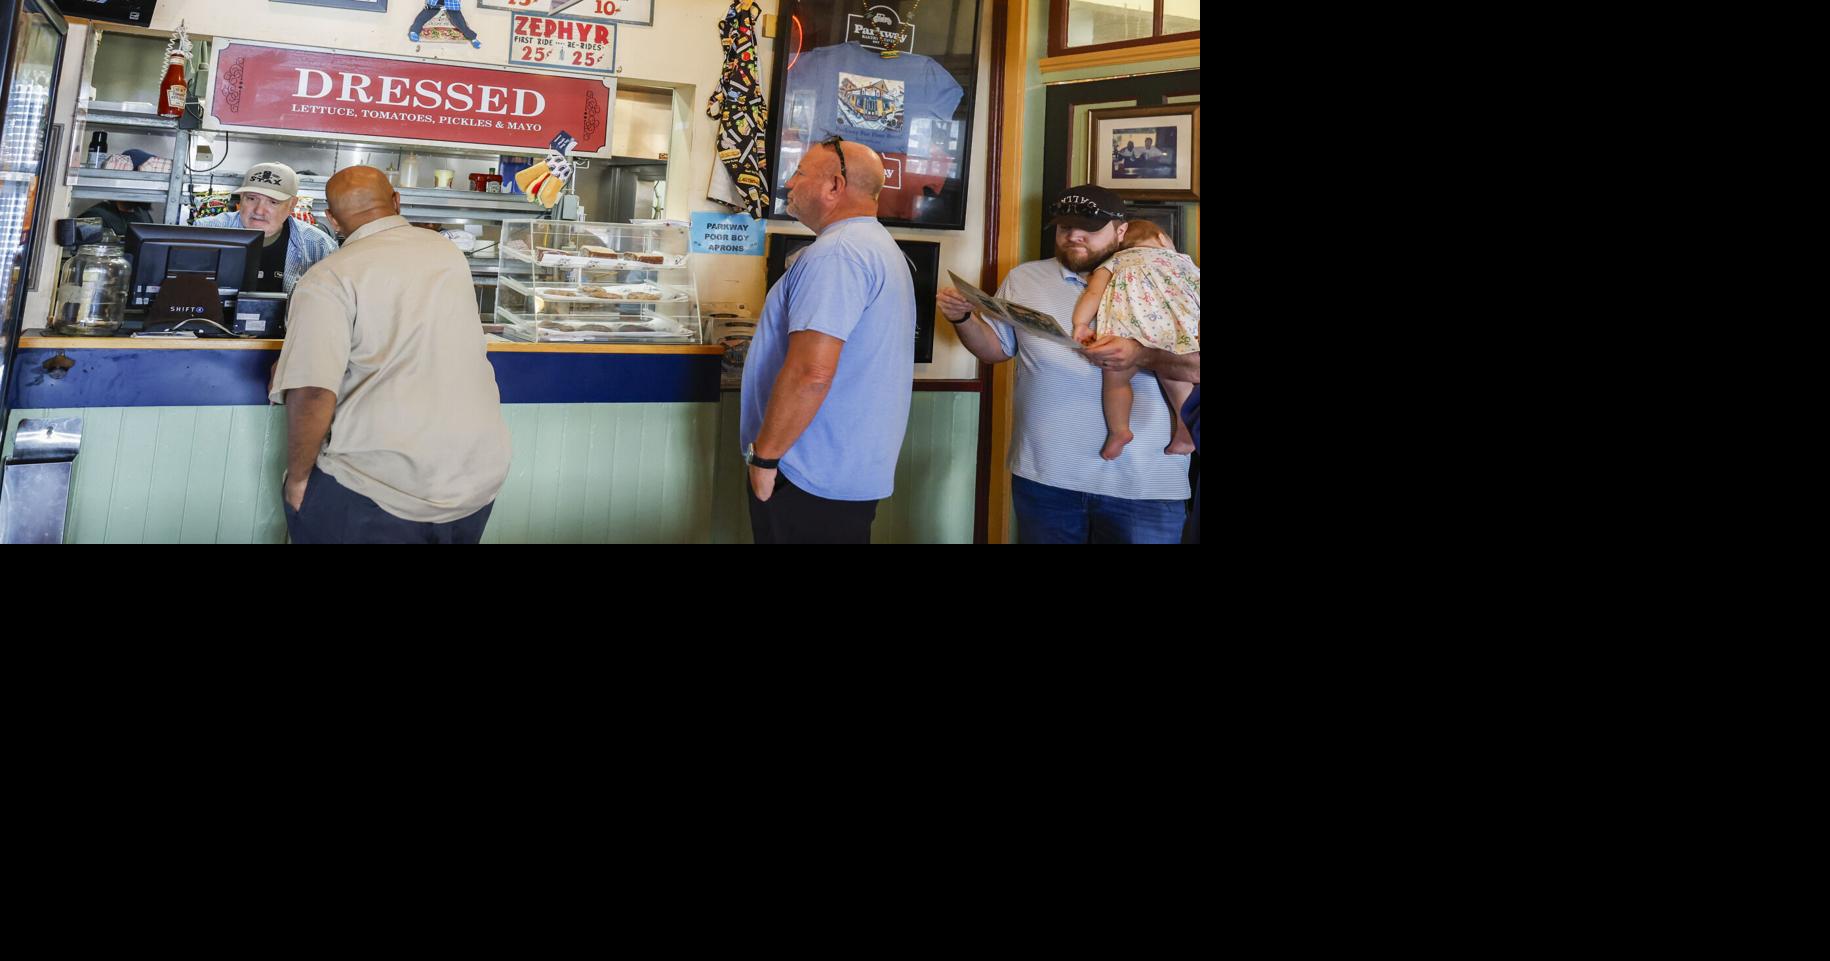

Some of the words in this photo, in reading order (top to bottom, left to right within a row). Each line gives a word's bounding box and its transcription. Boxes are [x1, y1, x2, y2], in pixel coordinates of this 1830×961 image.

[514, 16, 609, 45] ZEPHYR
[514, 36, 533, 44] FIRST
[537, 38, 553, 46] RIDE
[567, 41, 602, 51] RE-RIDES
[291, 68, 546, 117] DRESSED
[291, 104, 358, 117] LETTUCE,
[361, 109, 436, 125] TOMATOES,
[439, 116, 492, 128] PICKLES
[495, 121, 504, 129] &
[507, 122, 542, 132] MAYO
[250, 176, 282, 186] STAX
[706, 222, 749, 232] PARKWAY
[704, 233, 729, 241] POOR
[731, 234, 750, 242] BOY
[708, 244, 745, 252] APRONS
